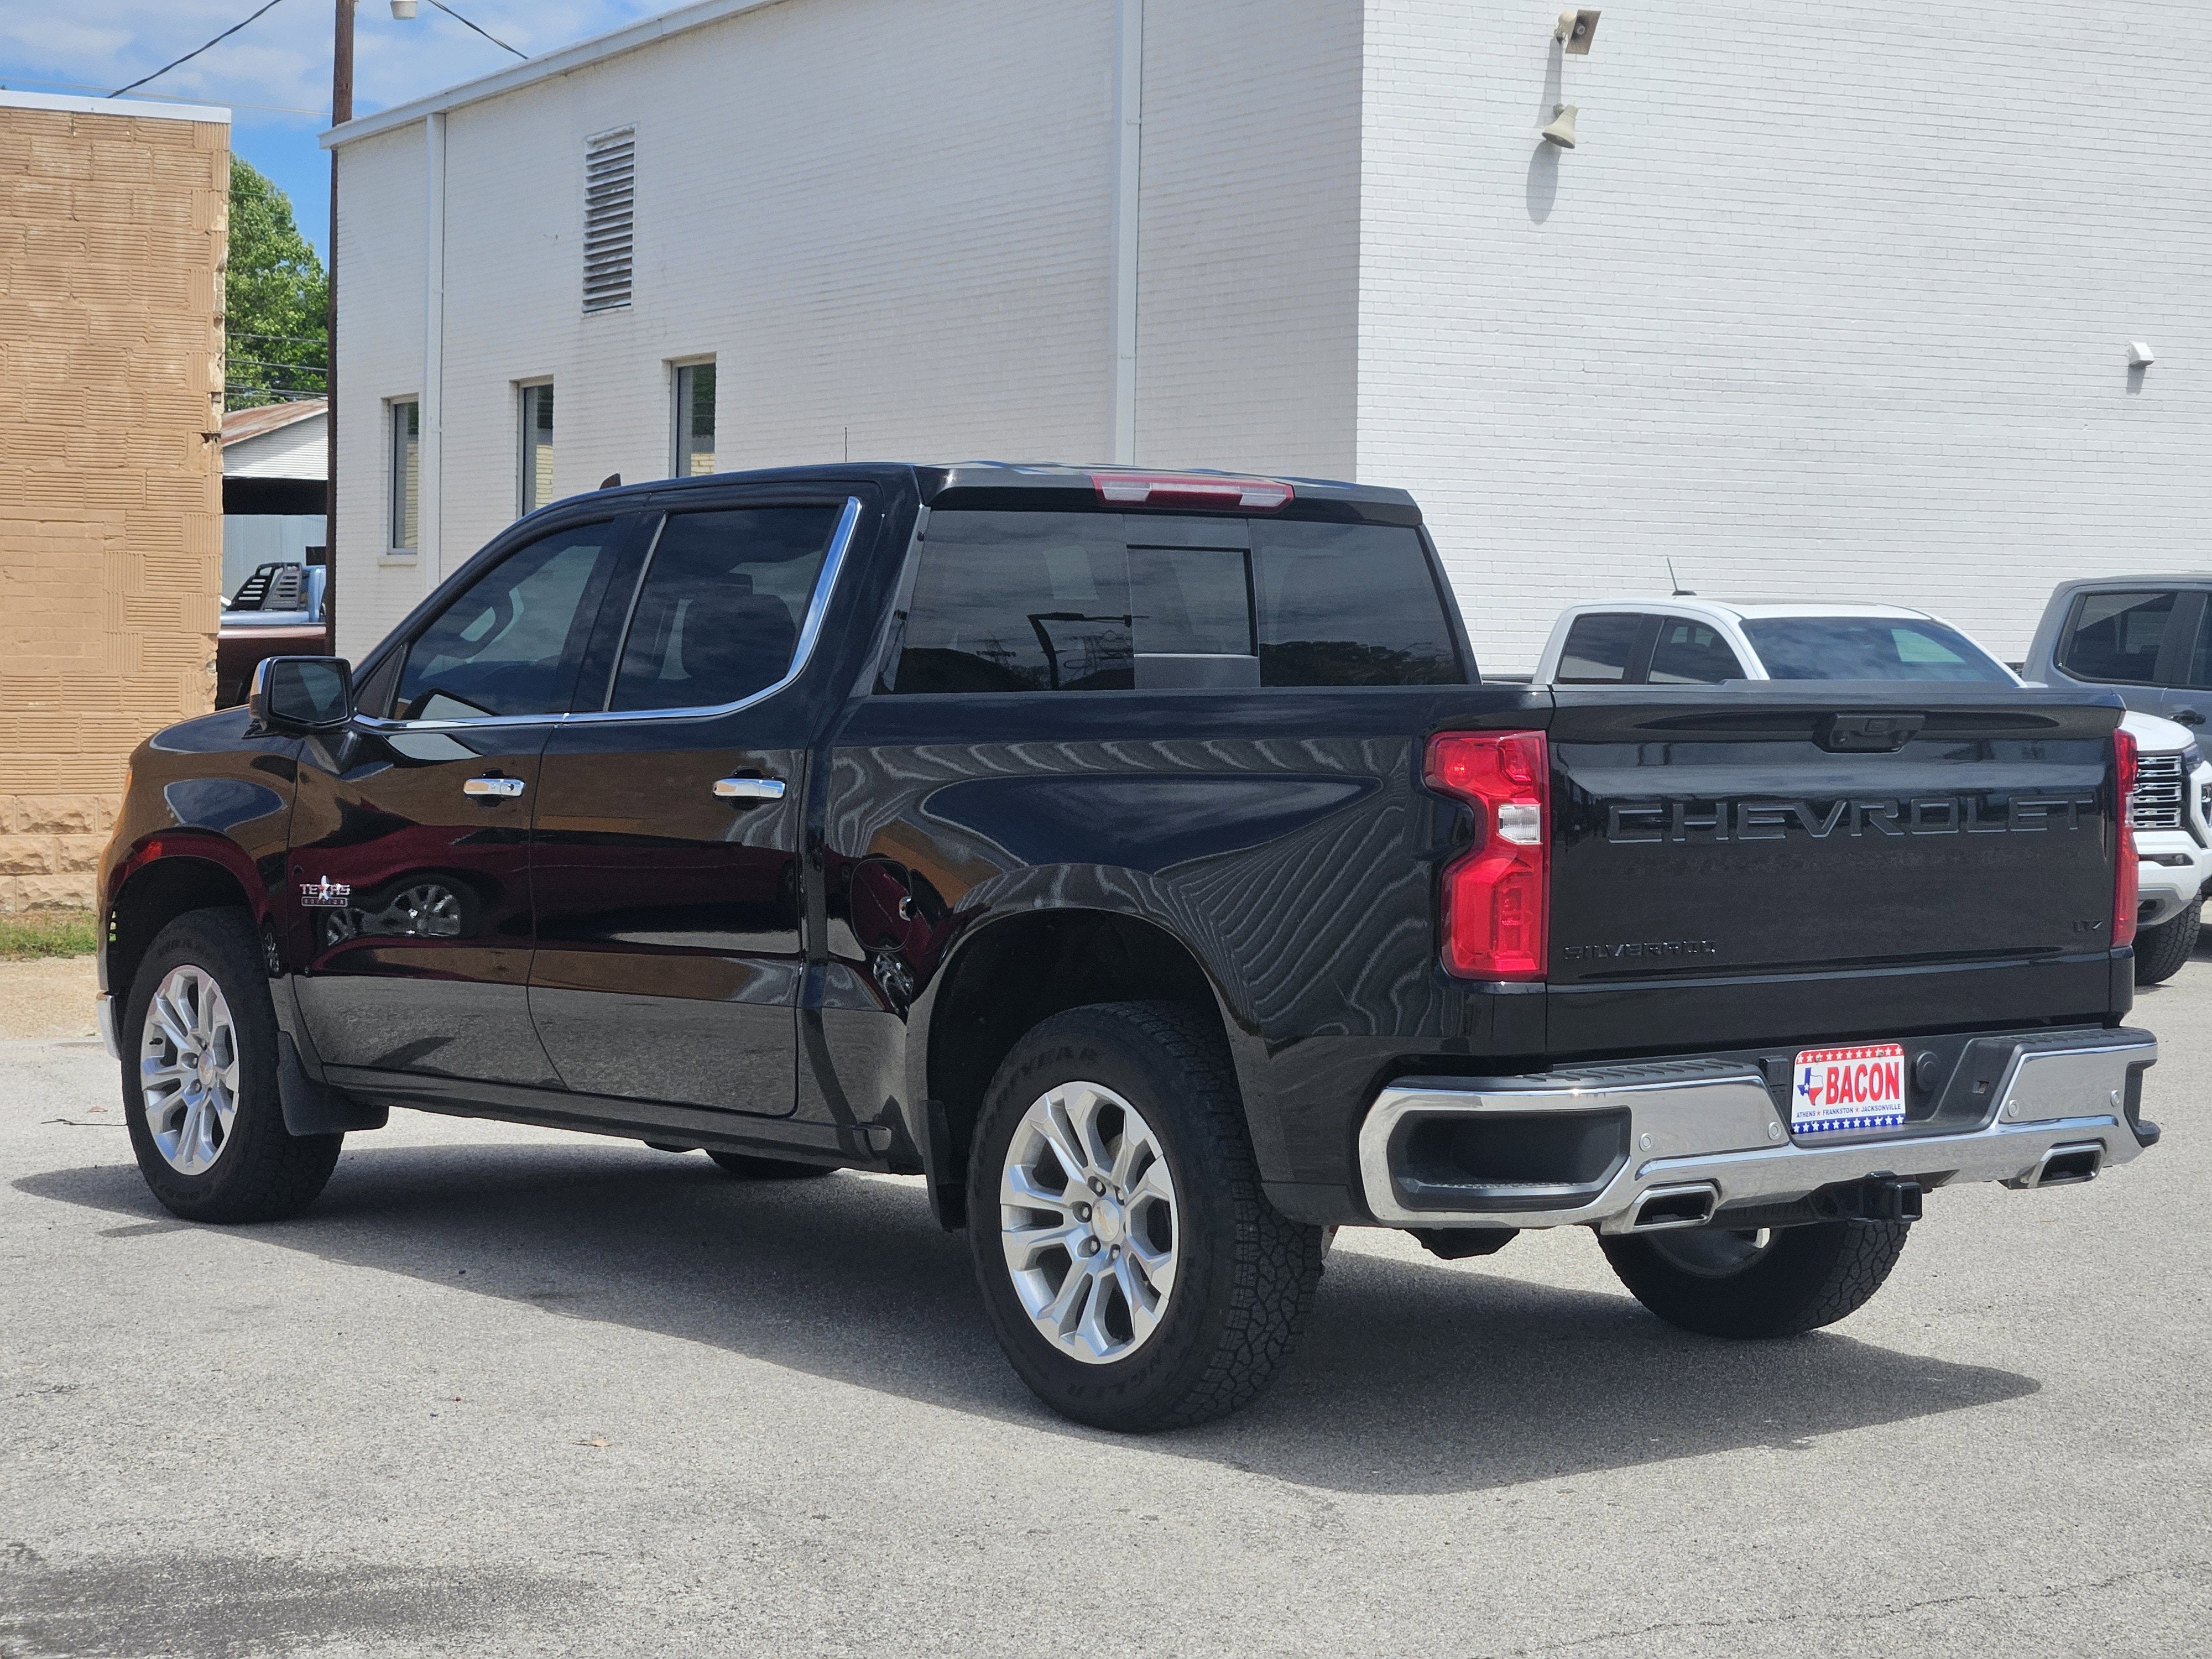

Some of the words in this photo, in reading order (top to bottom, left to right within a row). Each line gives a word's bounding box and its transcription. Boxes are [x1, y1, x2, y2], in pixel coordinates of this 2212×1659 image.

[1610, 795, 2094, 842] CHEVROLET
[299, 877, 351, 897] TEXAS
[1564, 940, 1716, 960] SILVERADO
[1825, 1062, 1899, 1105] BACON
[1822, 1107, 1854, 1115] FRANKSTON
[1861, 1104, 1901, 1113] JACKSONVILLE
